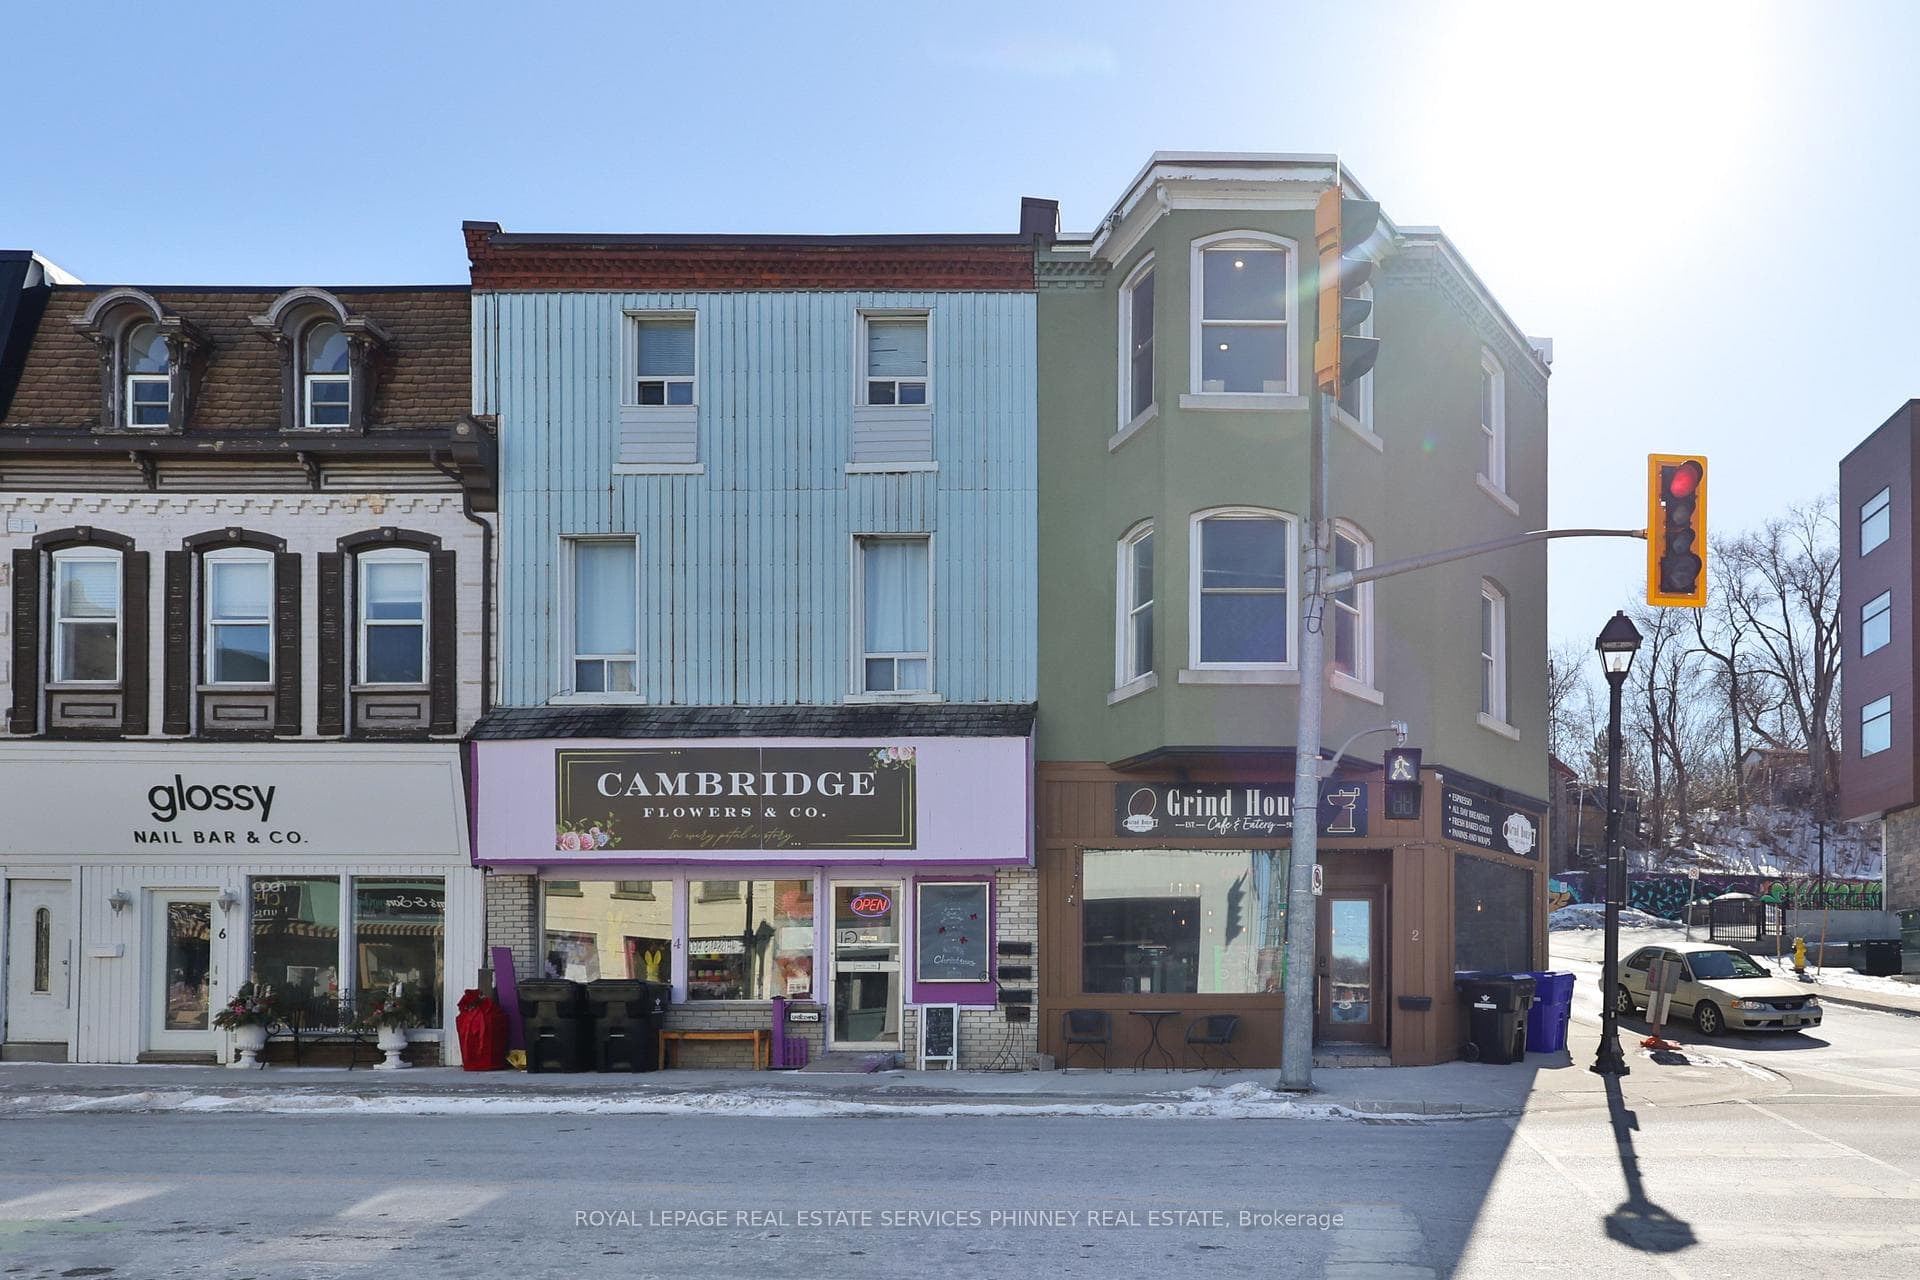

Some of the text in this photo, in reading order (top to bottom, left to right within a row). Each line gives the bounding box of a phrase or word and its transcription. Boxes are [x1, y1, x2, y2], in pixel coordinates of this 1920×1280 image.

[597, 771, 875, 797] CAMBRIDGE
[148, 774, 276, 822] glossy
[1167, 789, 1296, 816] Grind Hou
[644, 807, 826, 818] FLOWERS & CO.
[1207, 816, 1232, 835] Cafe
[1233, 816, 1240, 831] &
[1243, 817, 1275, 834] Eatery
[134, 831, 309, 844] NAIL BAR & CO.
[853, 898, 887, 911] OPEN
[219, 928, 226, 939] 6
[1411, 930, 1419, 941] 2
[673, 938, 682, 949] 4
